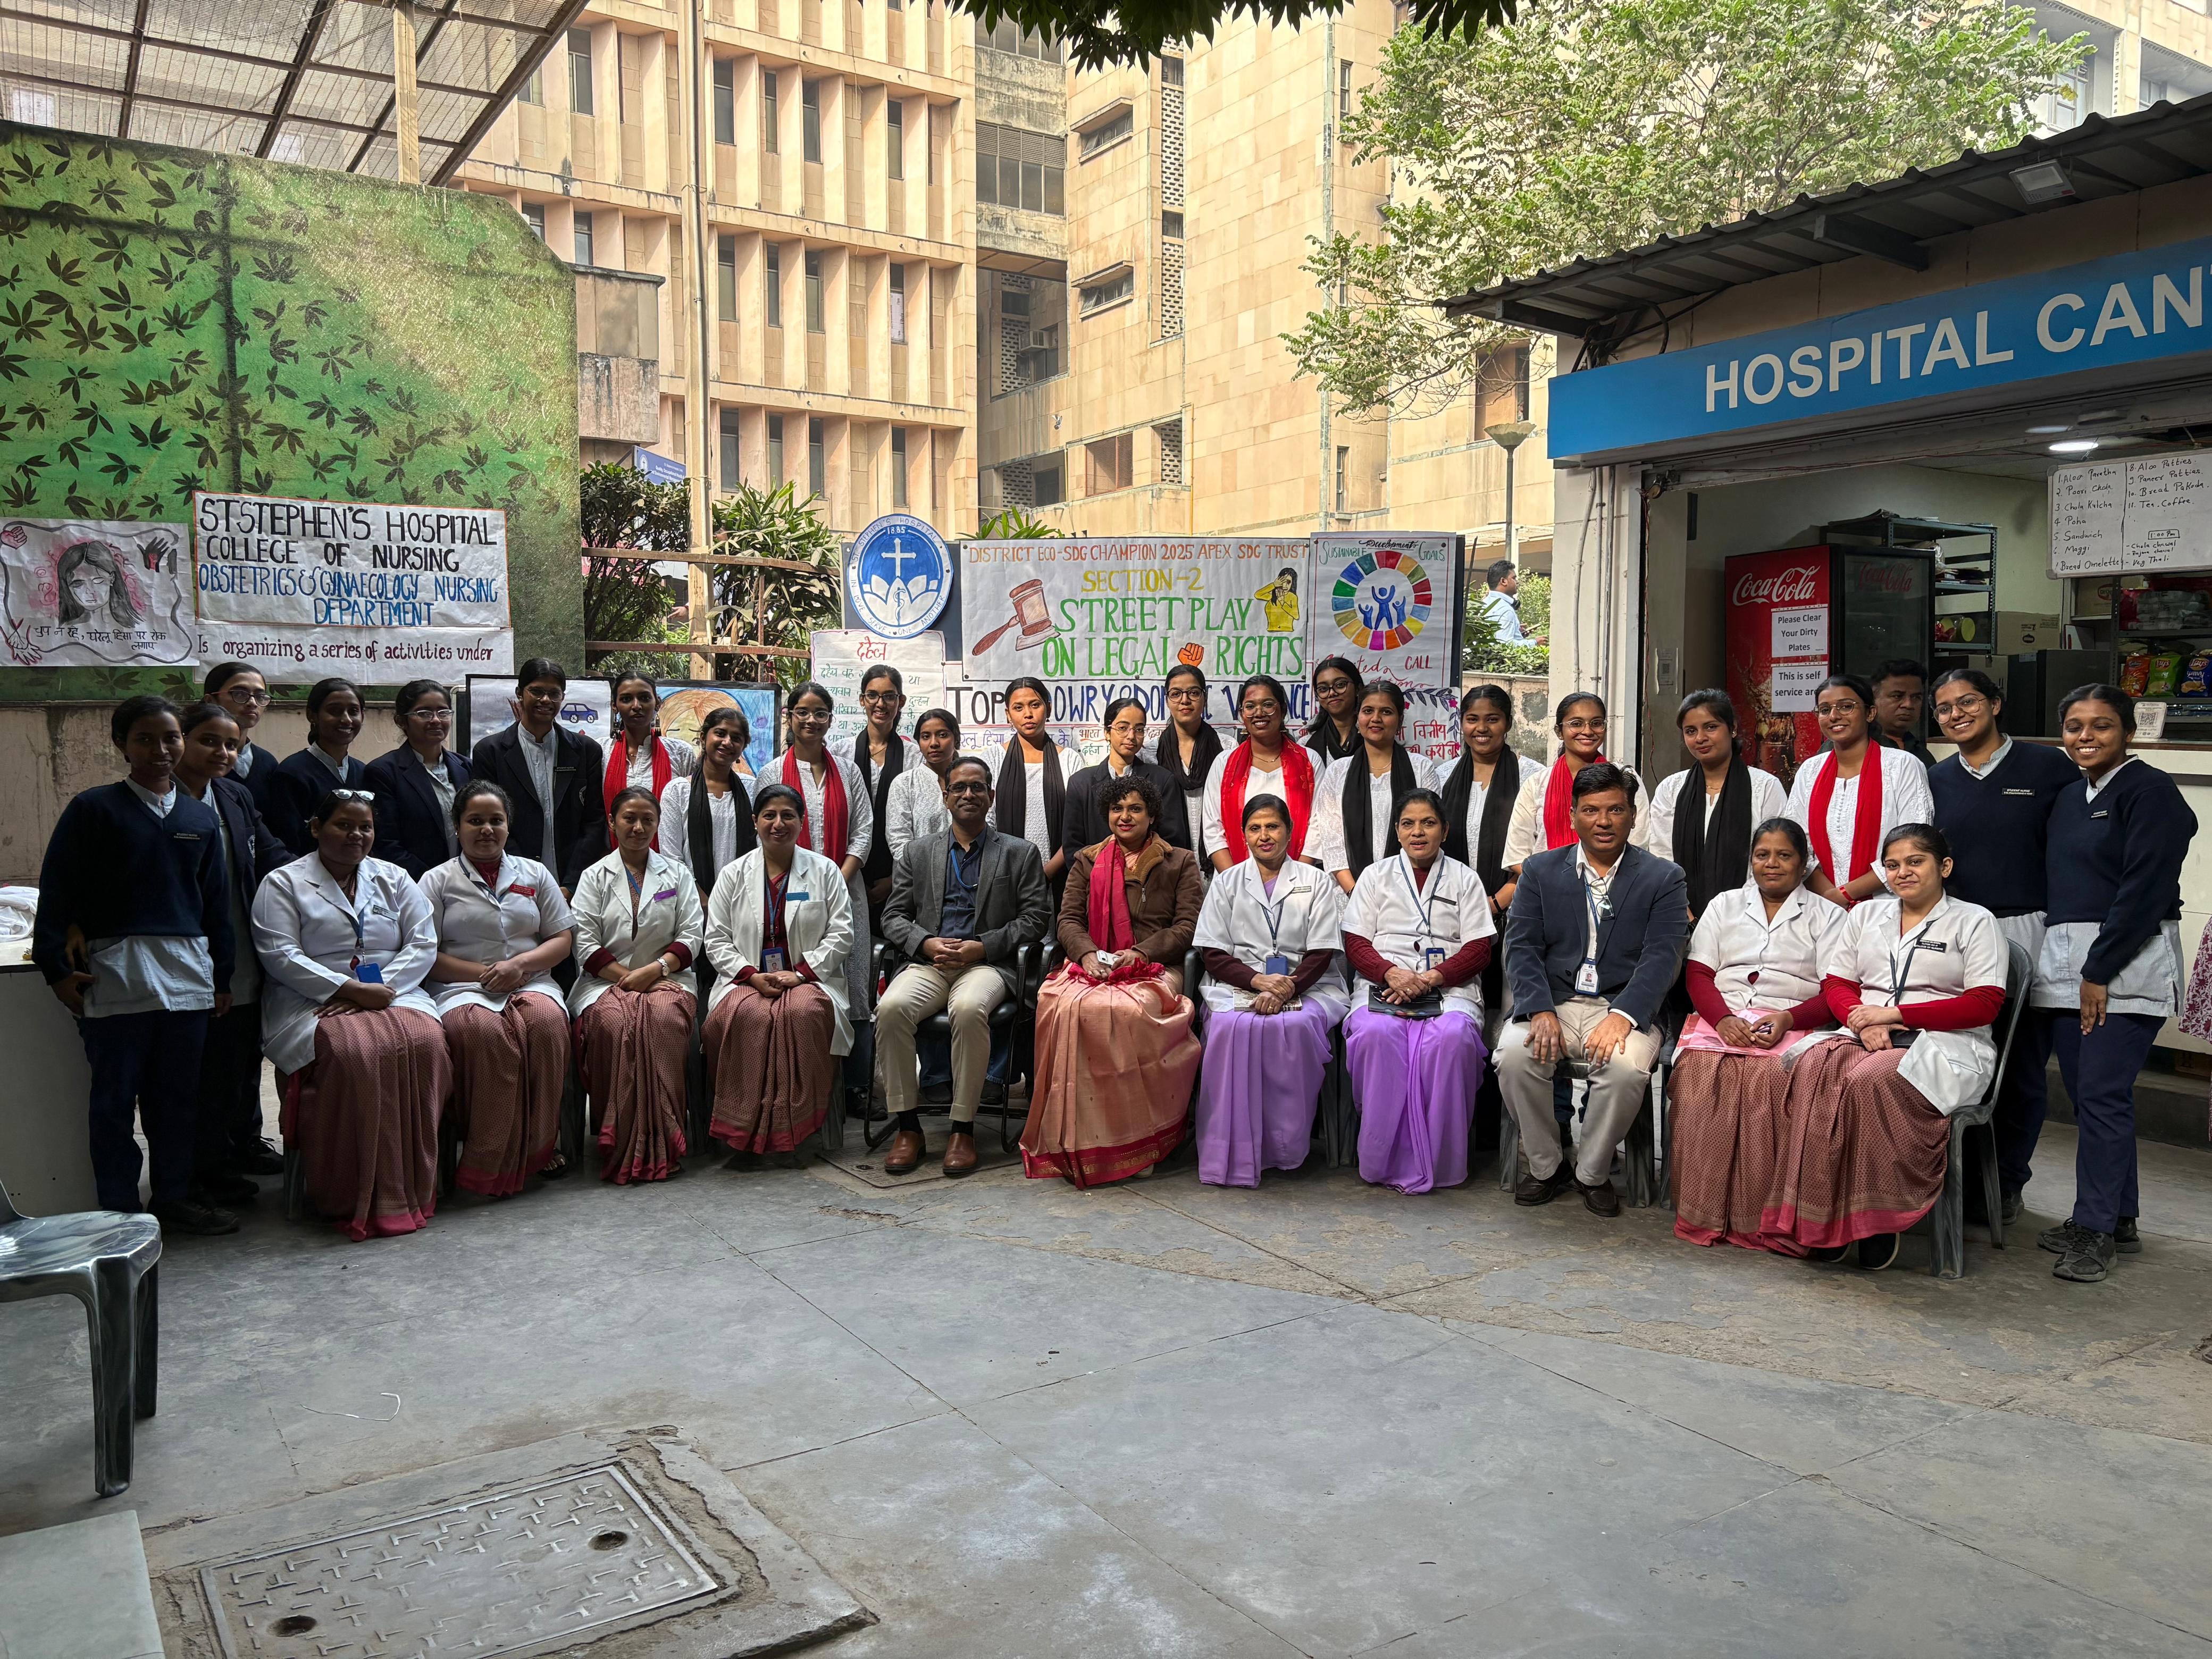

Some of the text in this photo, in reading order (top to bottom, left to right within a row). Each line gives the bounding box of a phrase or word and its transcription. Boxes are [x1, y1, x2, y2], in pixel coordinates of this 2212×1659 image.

[1706, 264, 2212, 413] HOSPITAL CAN
[2140, 483, 2169, 497] Bread
[386, 510, 497, 546] HOSPITAL
[887, 526, 906, 534] 1885
[2065, 515, 2086, 526] Poha
[858, 518, 891, 547] STEPHEN'S
[899, 517, 937, 543] HOSPITAL
[2063, 530, 2102, 541] Sandwich
[206, 535, 459, 572] COLLEGE OF NURSING
[969, 546, 1034, 563] DISTRICT
[1090, 544, 1157, 561] CHAMPION
[1161, 543, 1195, 560] 2025
[1197, 544, 1234, 559] APEX
[1237, 543, 1262, 559] SDG
[1265, 544, 1306, 559] TRUST
[1319, 541, 1367, 565] SUSTAINABLE
[2065, 545, 2090, 556] Maggi
[2060, 560, 2081, 571] Bread
[199, 564, 295, 596] OBSTETRICS
[320, 569, 421, 600] GYNAECOLOGY
[434, 576, 498, 603] NURSING
[1732, 565, 1821, 606] Coca-Cola
[314, 598, 434, 626] DEPARTMENT
[898, 627, 913, 636] ONE
[920, 594, 945, 626] ANOTHER
[1054, 596, 1254, 633] STREET PLAY
[54, 627, 64, 636] न
[134, 631, 147, 640] पर
[149, 629, 167, 641] रोक
[1800, 628, 1818, 636] Dirty
[198, 634, 493, 663] Is organizing a series of activities under
[1042, 636, 1079, 677] ON
[1214, 635, 1304, 677] RIGHTS
[1405, 655, 1433, 671] CALL
[1805, 671, 1821, 680] self
[1775, 688, 1803, 696] service
[1048, 684, 1115, 723] OWRY
[1079, 729, 1101, 739] भारत
